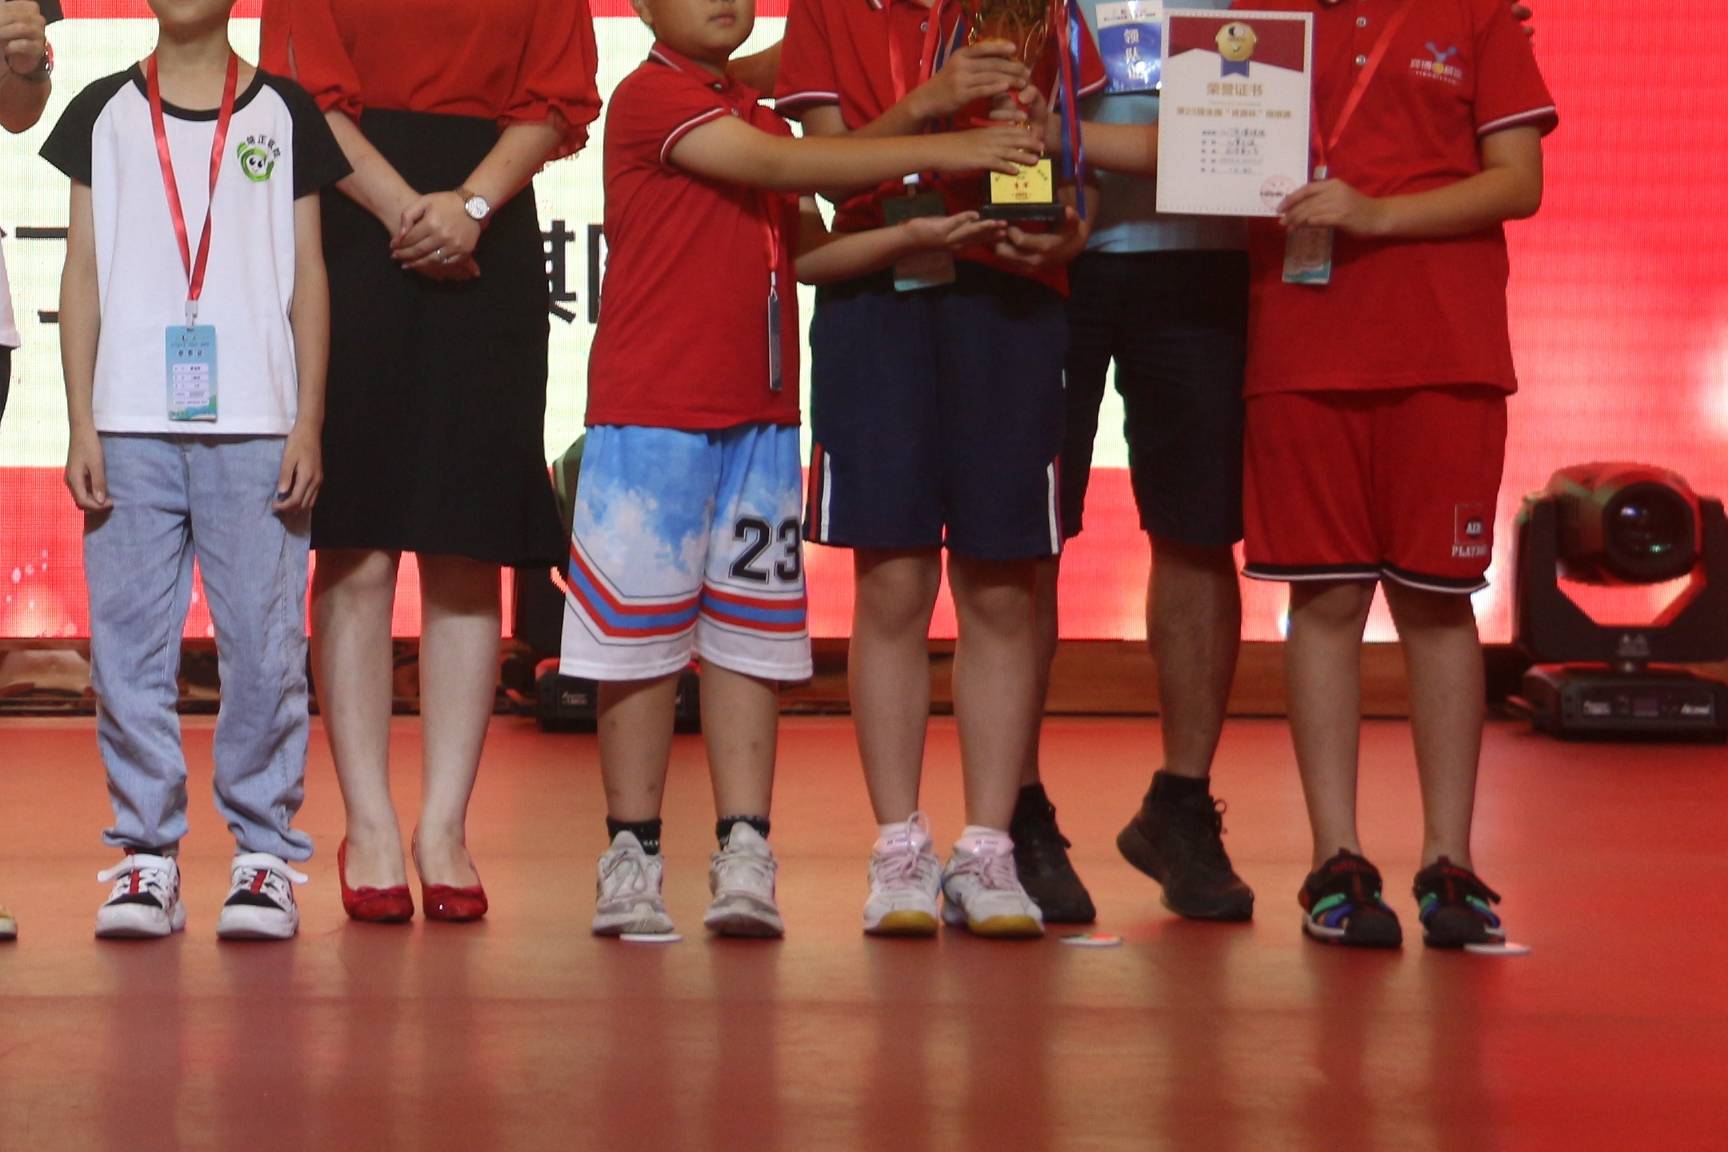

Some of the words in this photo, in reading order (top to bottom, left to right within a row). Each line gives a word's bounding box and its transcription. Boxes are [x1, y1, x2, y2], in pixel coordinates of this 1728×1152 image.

[1207, 83, 1264, 97] 荣誉证书
[728, 515, 801, 584] 23
